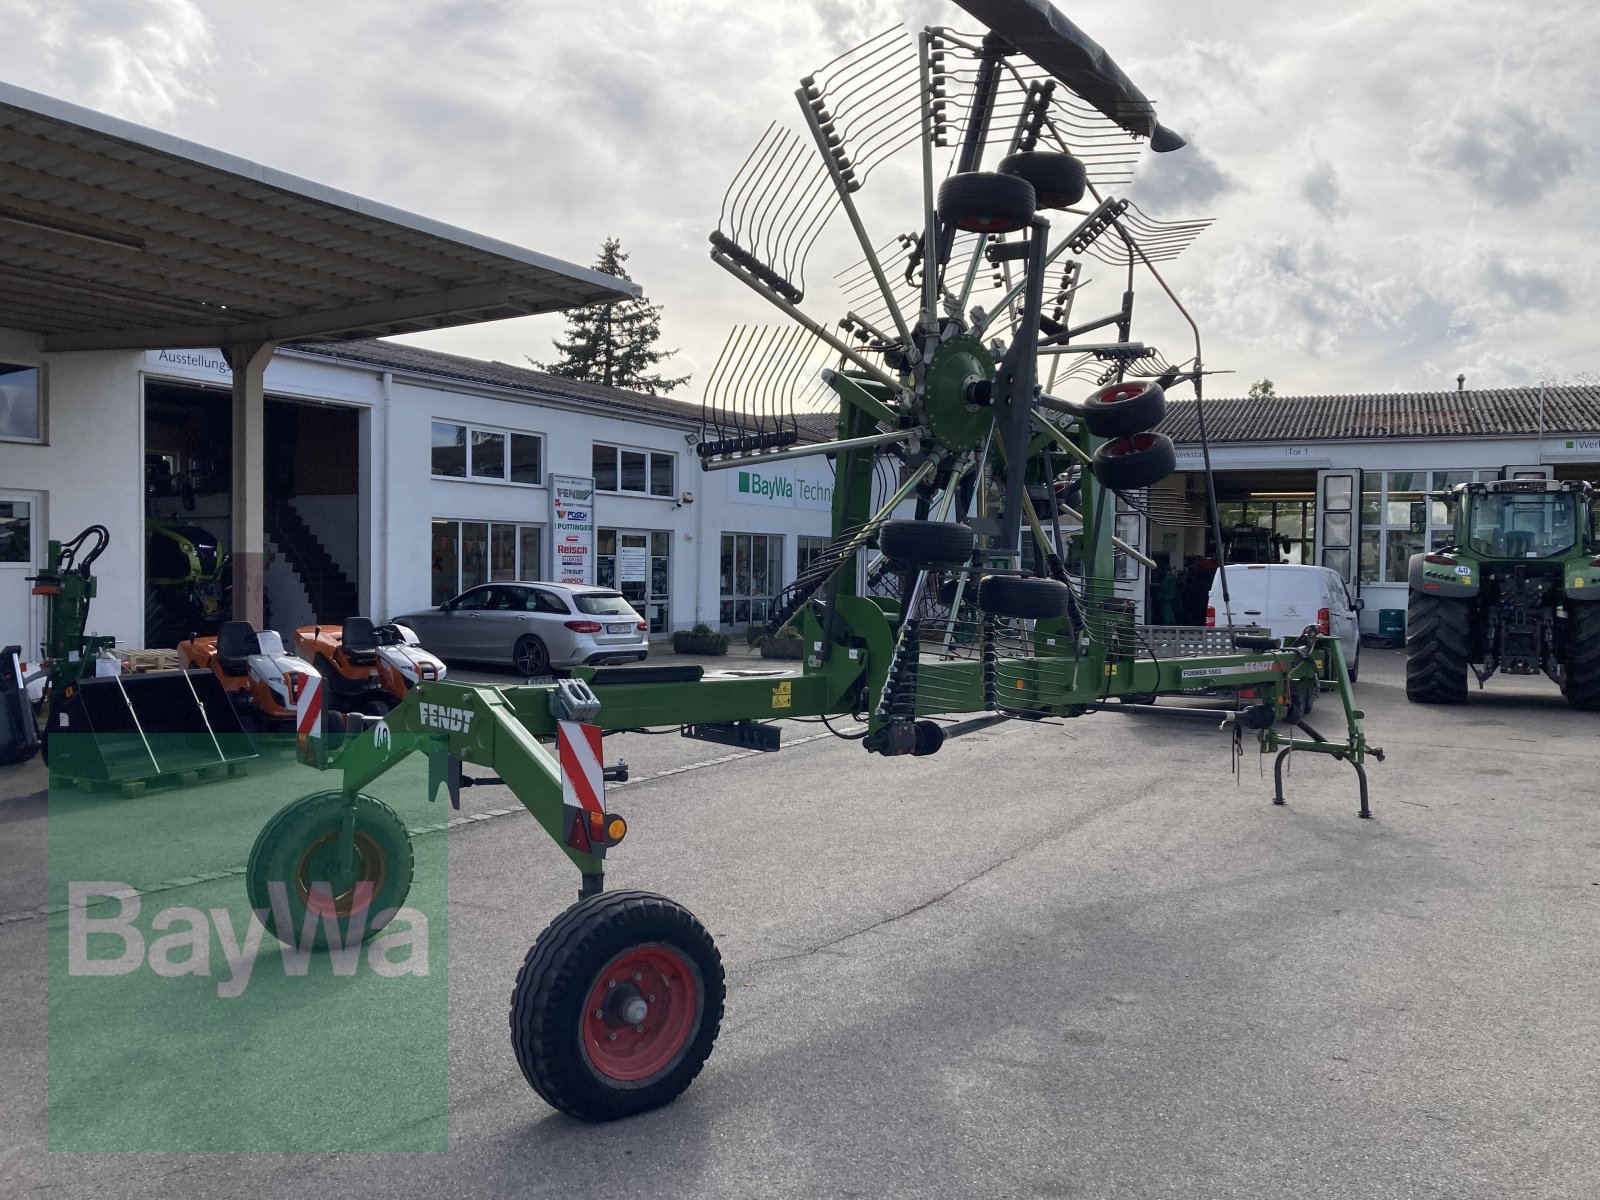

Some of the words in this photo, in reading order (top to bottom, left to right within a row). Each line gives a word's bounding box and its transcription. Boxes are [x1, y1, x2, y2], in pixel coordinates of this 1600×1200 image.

[1288, 448, 1301, 456] Tor
[752, 473, 793, 500] BayWa
[798, 479, 834, 502] Techni
[557, 544, 588, 555] Reisch
[1244, 660, 1275, 671] FENDT
[1183, 669, 1208, 677] FORMER
[419, 701, 475, 734] FENDT
